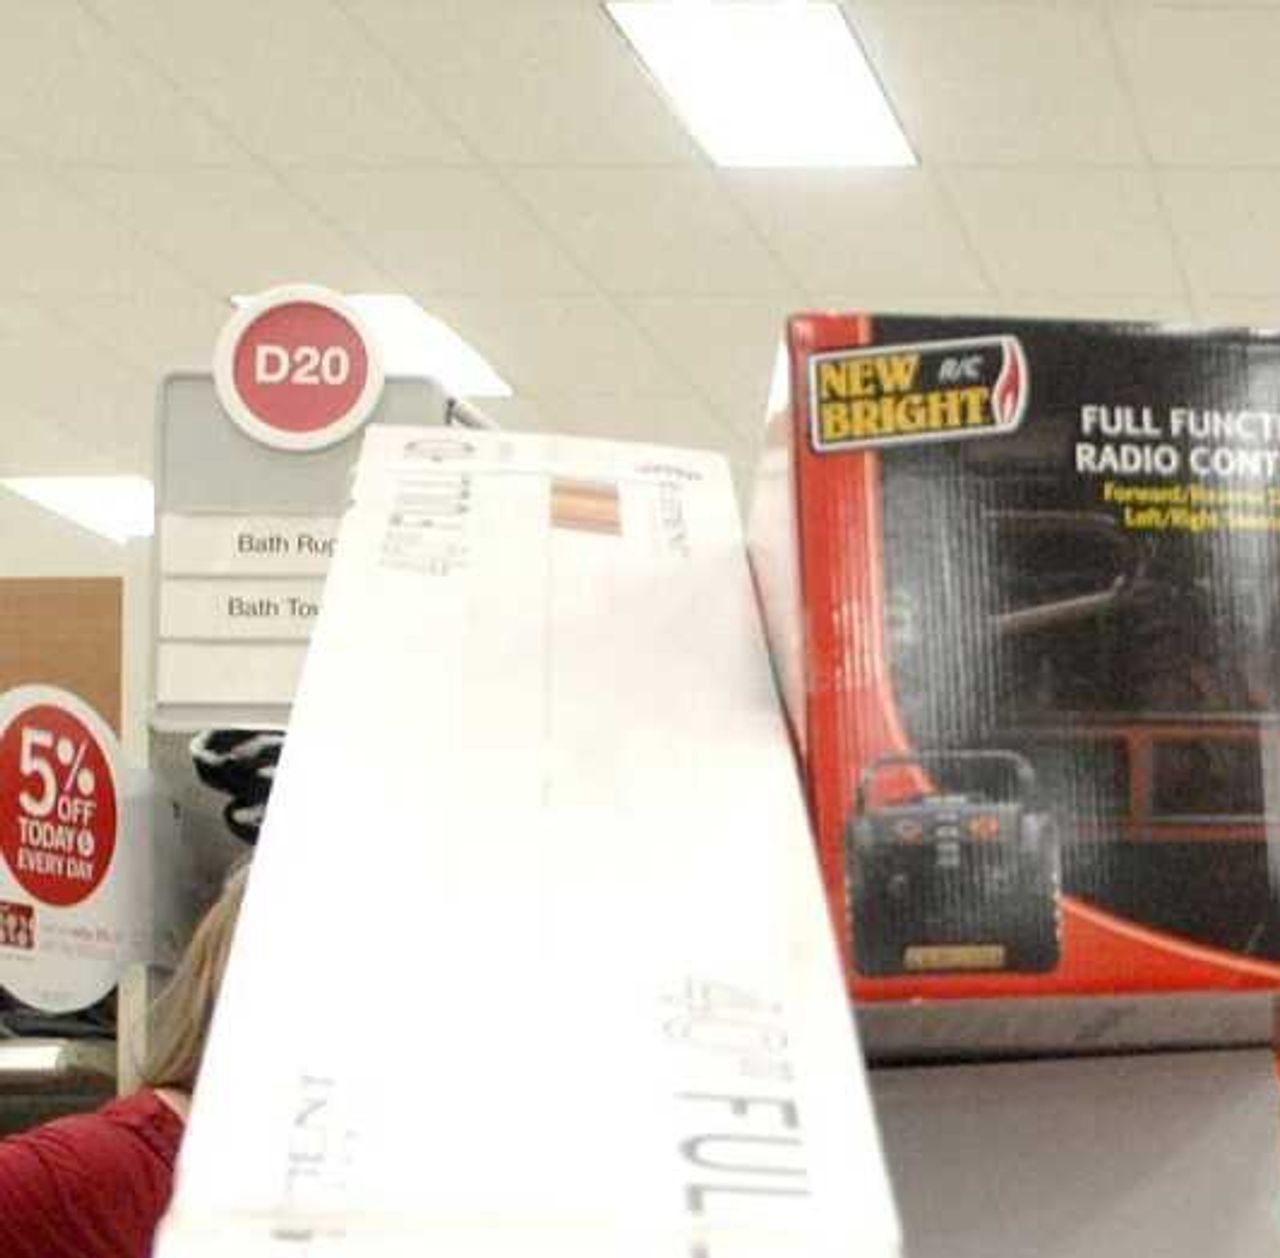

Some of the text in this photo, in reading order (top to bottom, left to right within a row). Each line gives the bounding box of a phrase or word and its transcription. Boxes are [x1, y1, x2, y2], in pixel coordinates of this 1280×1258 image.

[254, 344, 350, 385] D20
[819, 352, 983, 399] NEW R/C
[822, 387, 990, 441] BRIGHT
[1080, 404, 1161, 437] FULL
[1075, 442, 1178, 475] RADIO
[237, 533, 289, 554] Bath
[227, 597, 279, 617] Bath
[18, 727, 96, 818] 5%
[57, 794, 97, 827] OFF
[17, 817, 77, 853] TODAY
[18, 847, 94, 881] EVERY DAY
